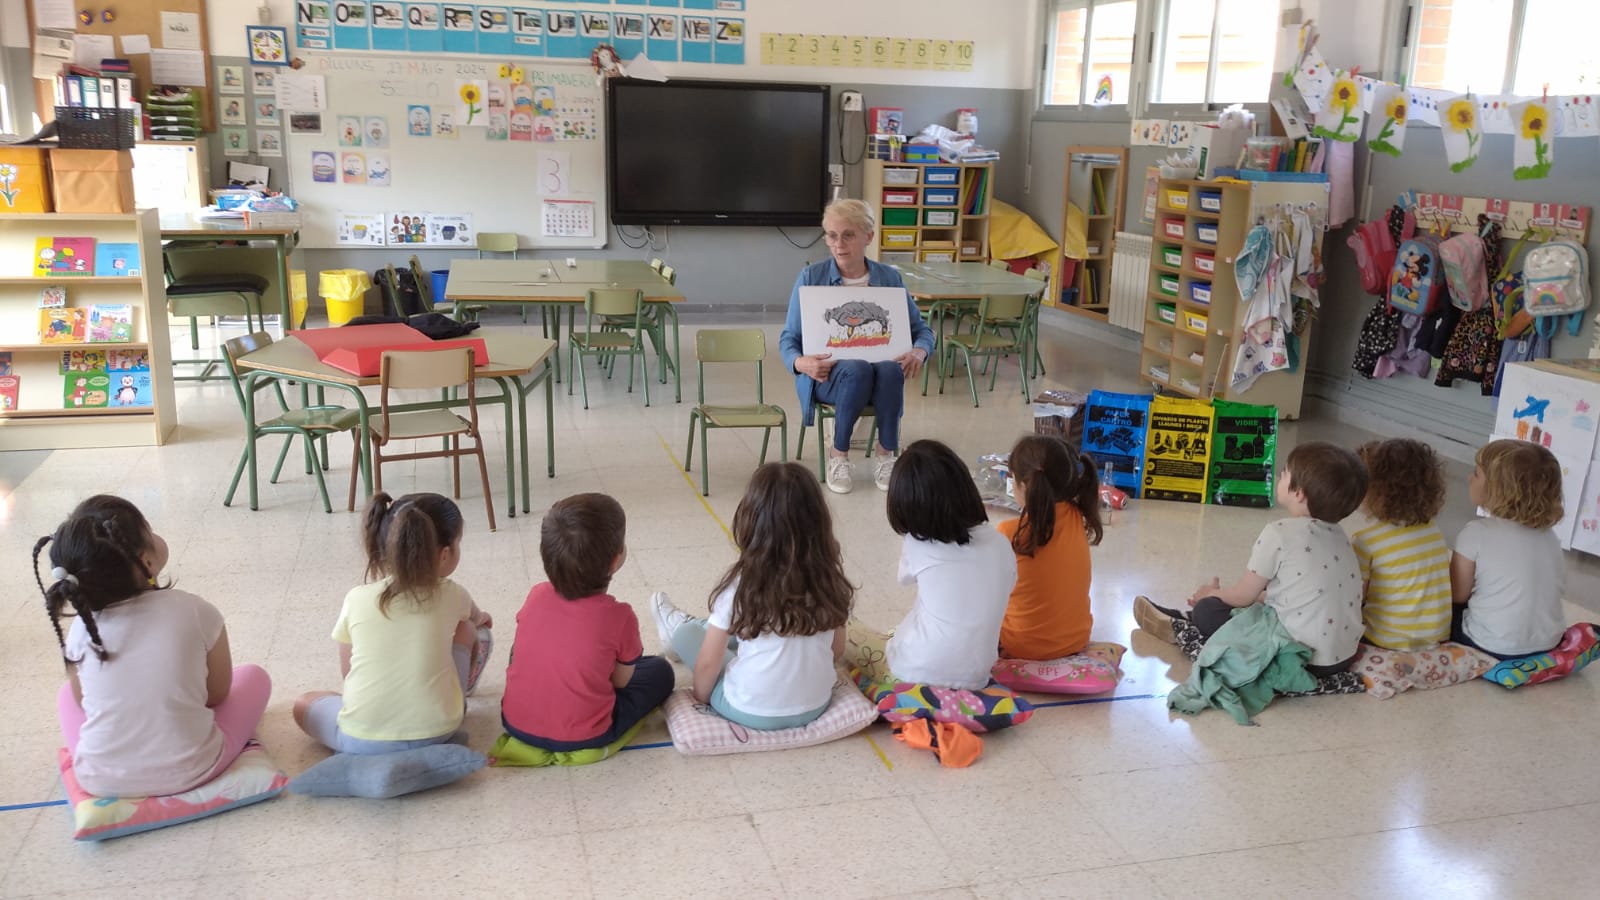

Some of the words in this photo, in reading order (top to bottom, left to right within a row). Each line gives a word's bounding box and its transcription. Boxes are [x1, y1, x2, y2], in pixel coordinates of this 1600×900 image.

[298, 3, 313, 23] N
[335, 3, 350, 23] O
[371, 5, 385, 25] P
[408, 7, 422, 26] Q
[444, 8, 457, 27] R
[480, 10, 493, 29] S
[512, 11, 527, 31] T
[547, 14, 560, 33] U
[581, 14, 594, 34] V
[614, 15, 628, 36] W
[649, 17, 662, 37] X
[716, 21, 729, 40] Z
[768, 37, 774, 51] 1
[789, 38, 796, 53] 2
[810, 39, 818, 54] 3
[832, 40, 840, 54] 4
[854, 40, 862, 55] 5
[875, 41, 884, 55] 6
[897, 42, 906, 56] 7
[917, 43, 926, 57] 8
[939, 44, 947, 58] 9
[958, 45, 972, 59] 10
[1152, 123, 1160, 143] 2
[1170, 124, 1179, 144] 3
[546, 158, 561, 193] 3
